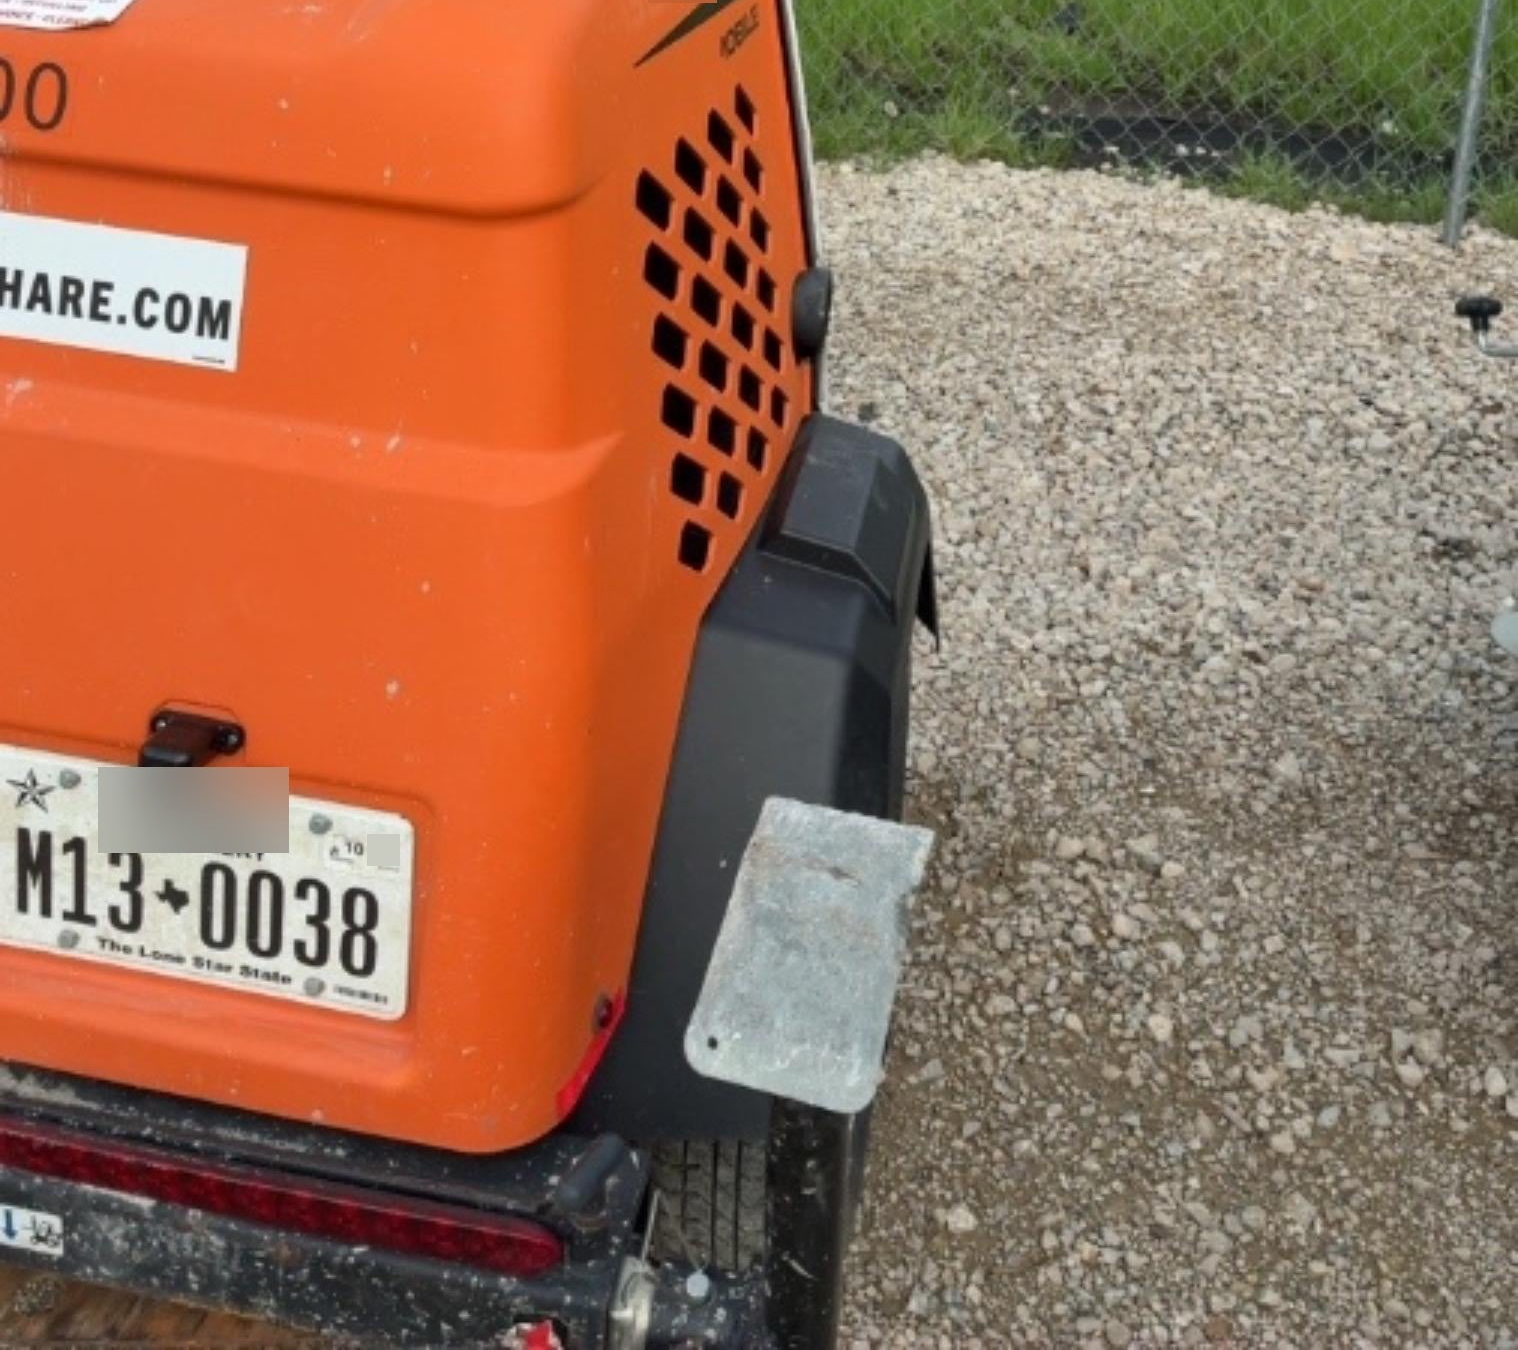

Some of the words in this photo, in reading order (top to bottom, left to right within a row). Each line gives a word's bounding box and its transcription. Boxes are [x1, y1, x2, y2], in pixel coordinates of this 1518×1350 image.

[16, 827, 144, 933] M13
[199, 862, 380, 978] 0038
[96, 936, 133, 954] The
[139, 945, 187, 964] Lone
[193, 954, 234, 974] Star
[239, 964, 293, 986] State
